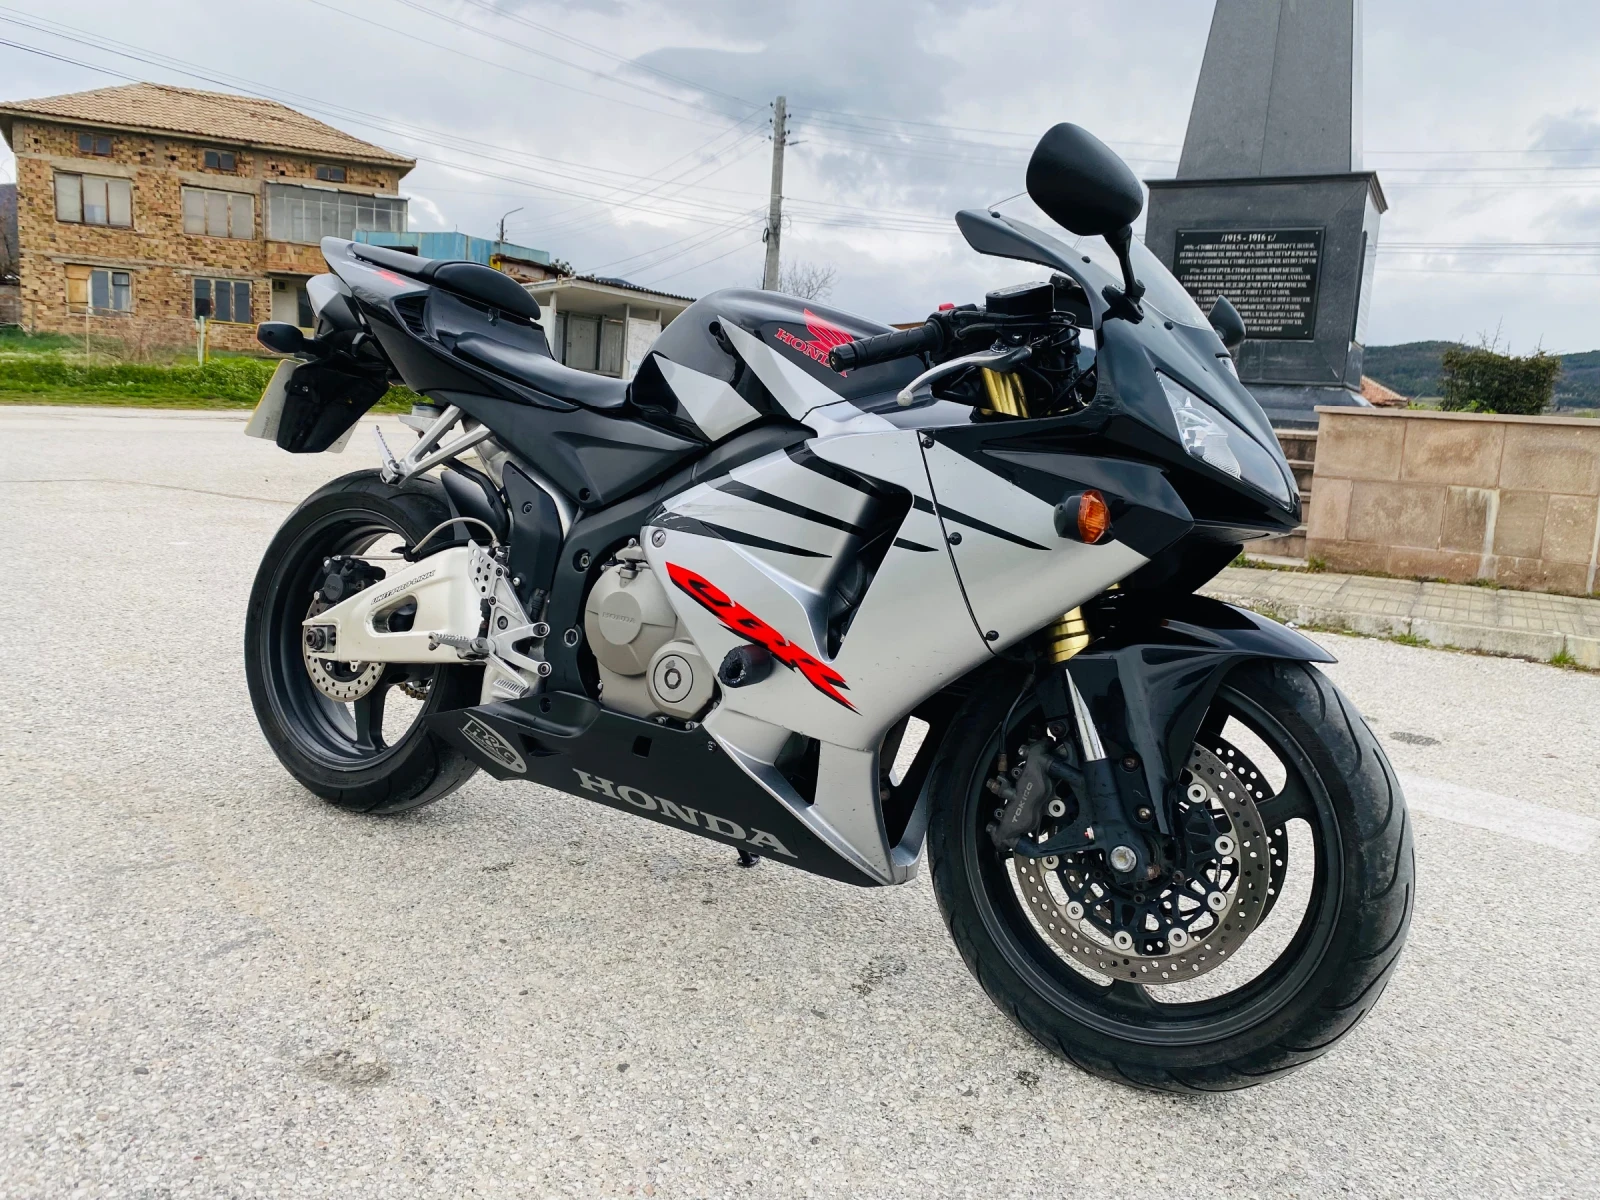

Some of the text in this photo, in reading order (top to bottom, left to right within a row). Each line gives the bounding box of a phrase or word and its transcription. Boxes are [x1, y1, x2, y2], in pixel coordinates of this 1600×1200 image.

[1248, 233, 1266, 241] 1916
[572, 767, 799, 859] HONDA
[1011, 782, 1034, 823] TOKICO
